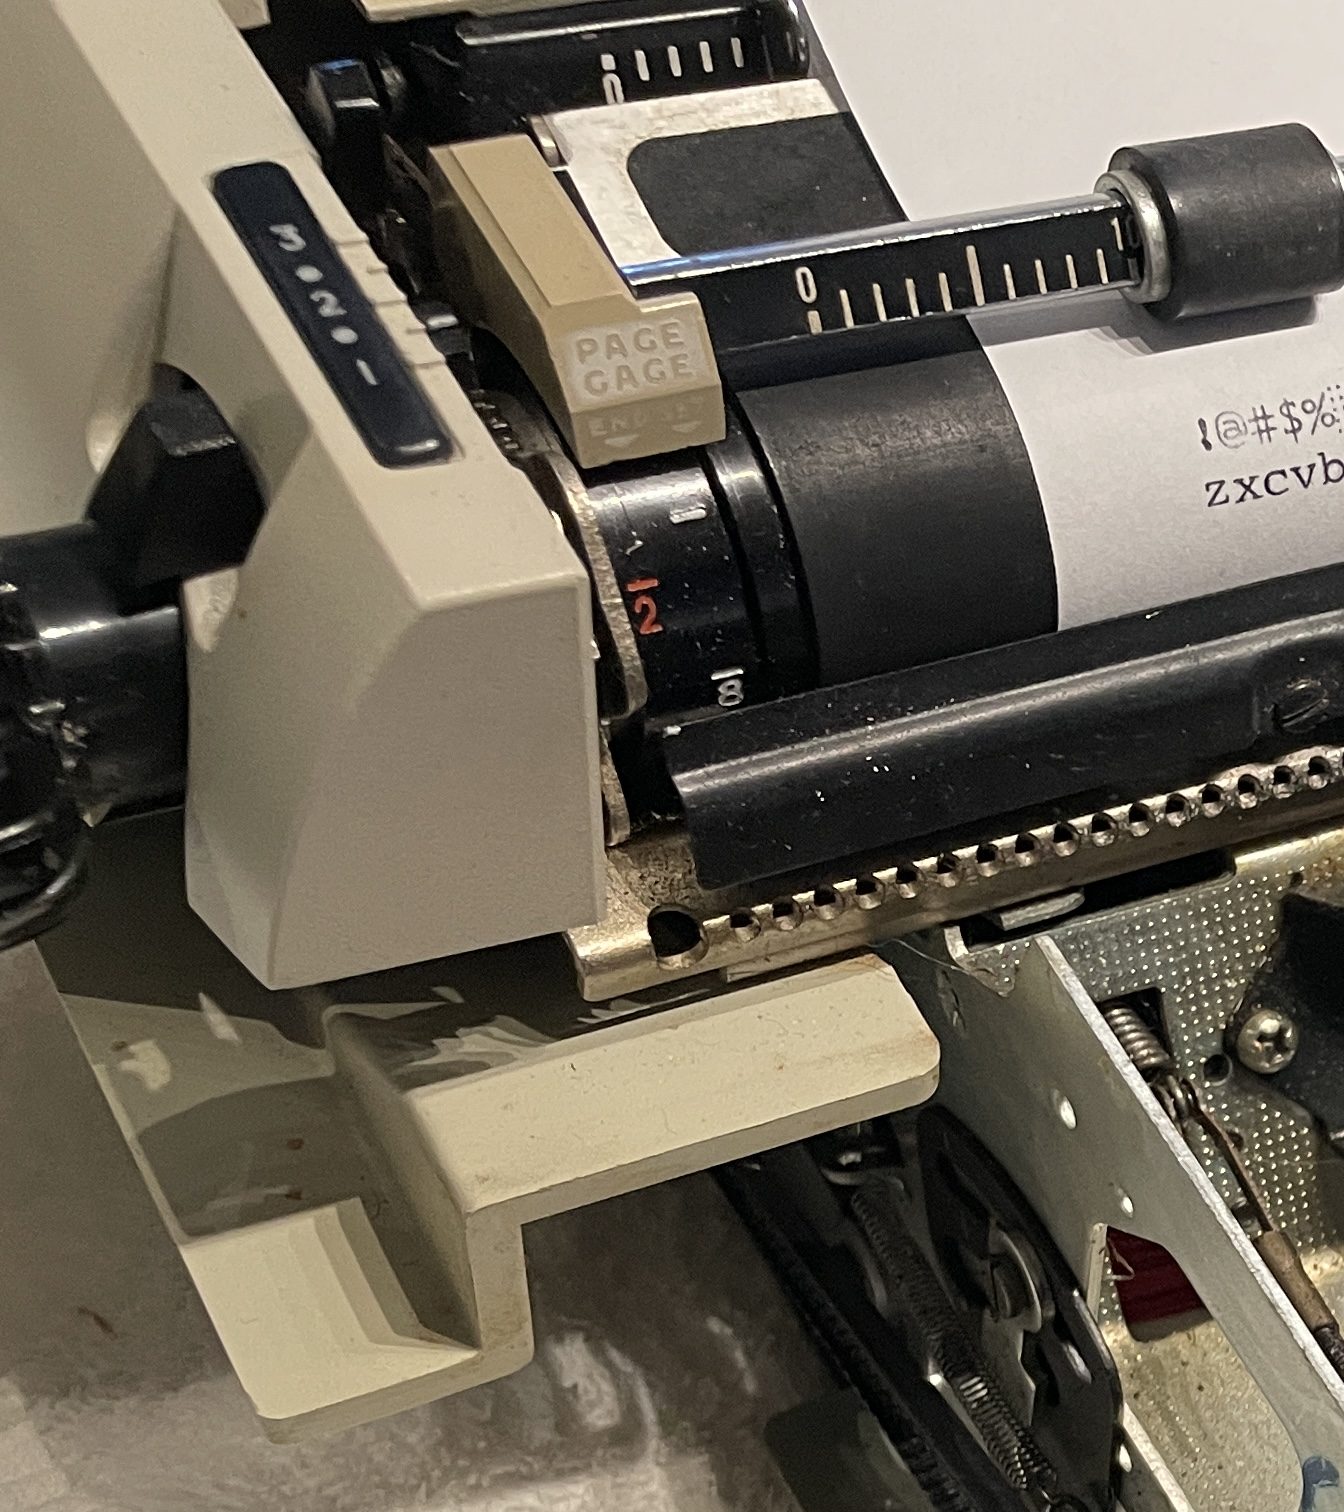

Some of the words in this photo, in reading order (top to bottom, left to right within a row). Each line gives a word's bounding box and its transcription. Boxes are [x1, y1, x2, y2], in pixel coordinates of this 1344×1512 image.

[795, 266, 818, 305] 0
[575, 321, 684, 364] PAGE
[584, 353, 693, 396] GAGE
[634, 597, 664, 635] 2
[718, 679, 744, 707] 8
